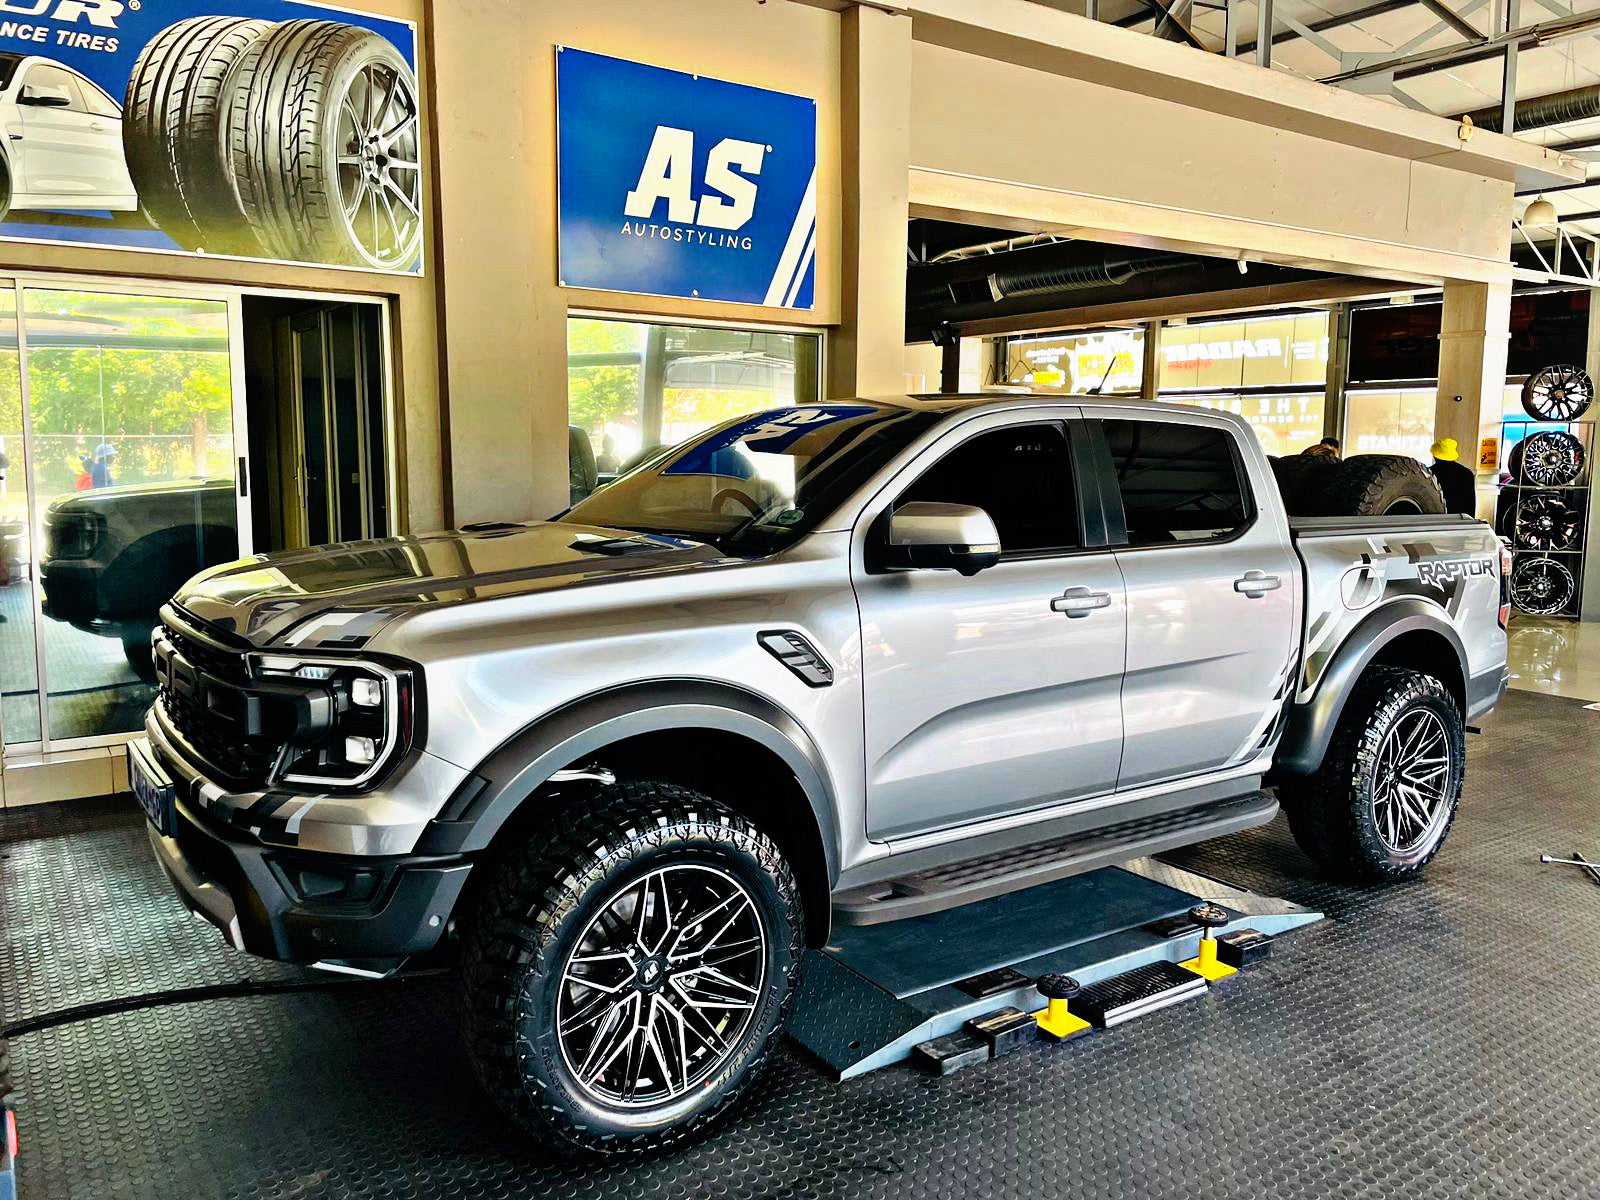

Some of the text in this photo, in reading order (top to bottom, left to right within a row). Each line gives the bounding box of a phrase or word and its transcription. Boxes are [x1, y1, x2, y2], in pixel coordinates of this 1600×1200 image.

[56, 29, 119, 53] TIRES
[624, 125, 766, 231] AS
[621, 222, 752, 250] AUTOSTYLING
[1416, 558, 1498, 592] RAPTOR
